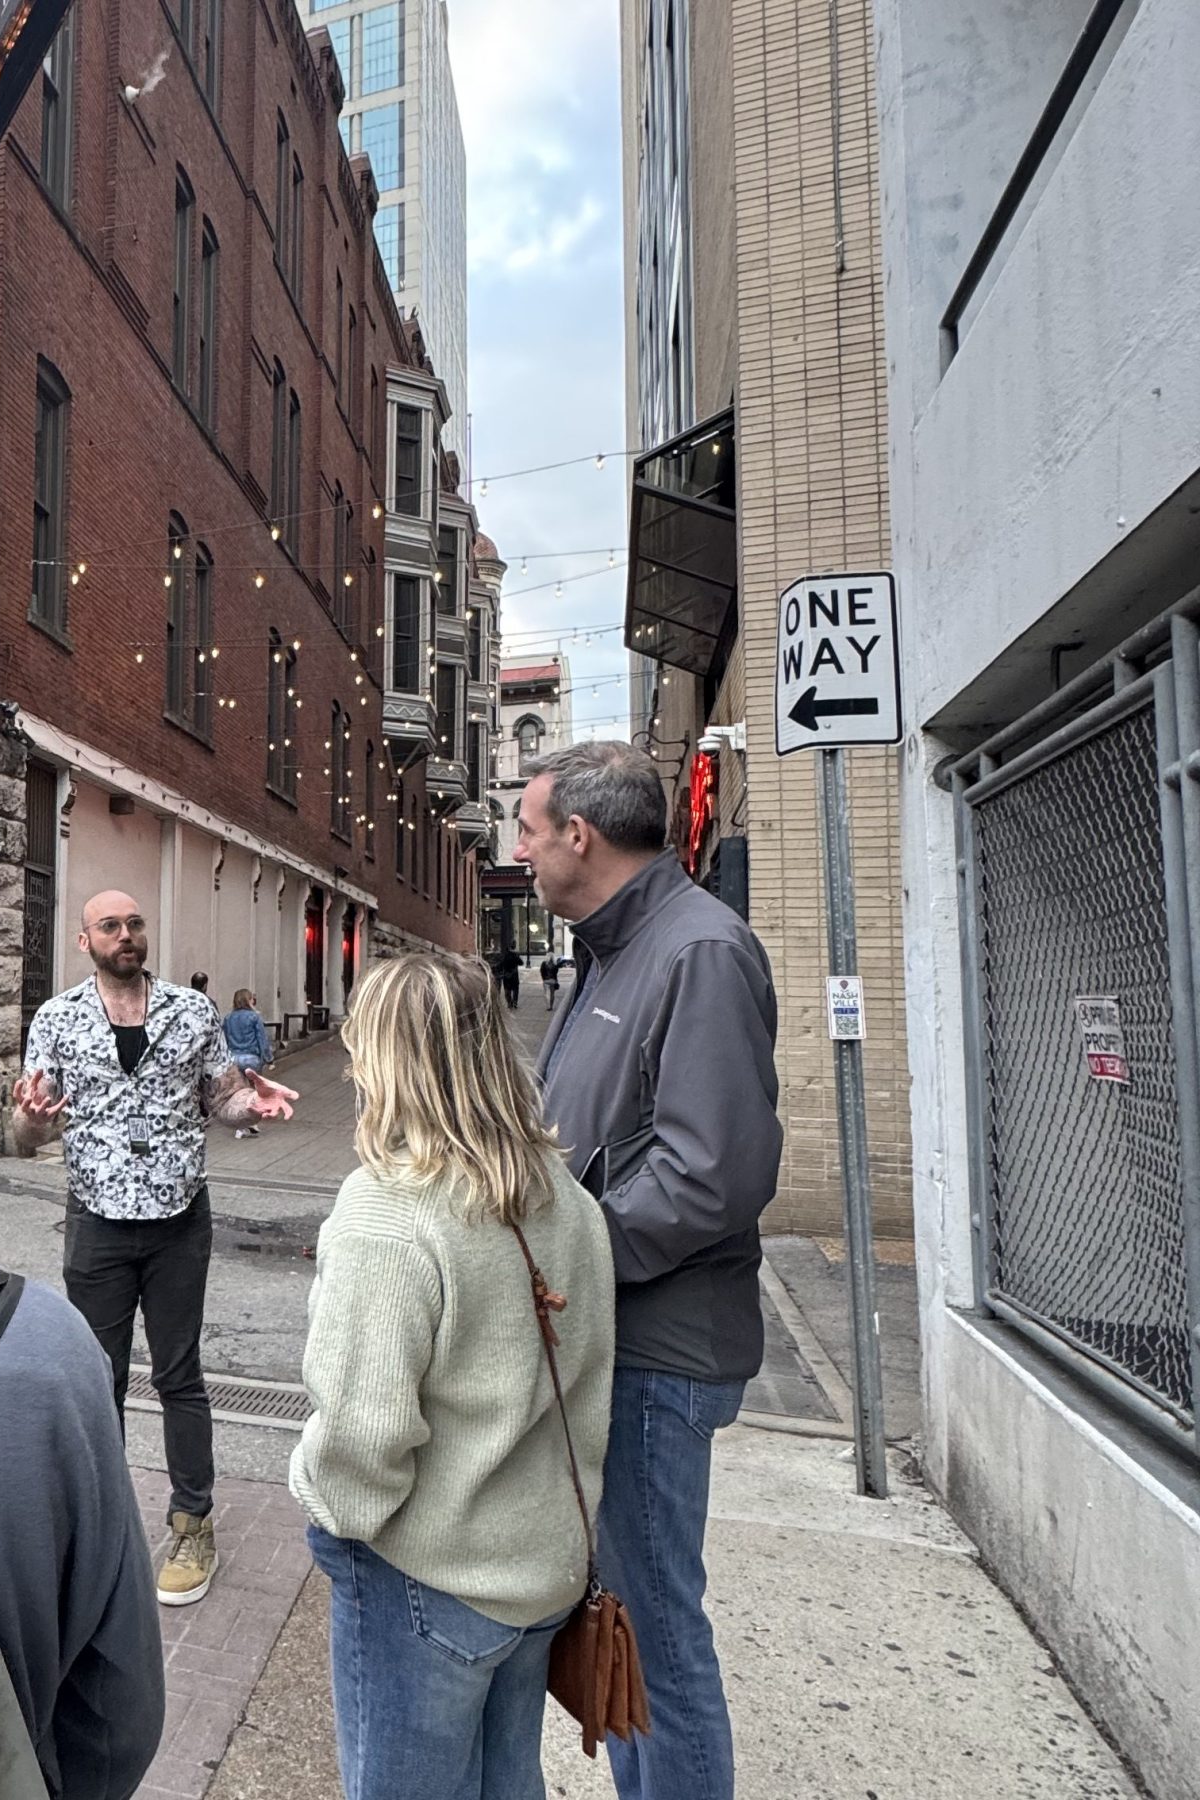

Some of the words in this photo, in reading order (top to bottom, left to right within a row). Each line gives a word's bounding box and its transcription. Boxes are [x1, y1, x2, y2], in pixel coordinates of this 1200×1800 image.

[785, 587, 876, 636] ONE
[783, 635, 881, 684] WAY
[832, 992, 858, 1000] NASH
